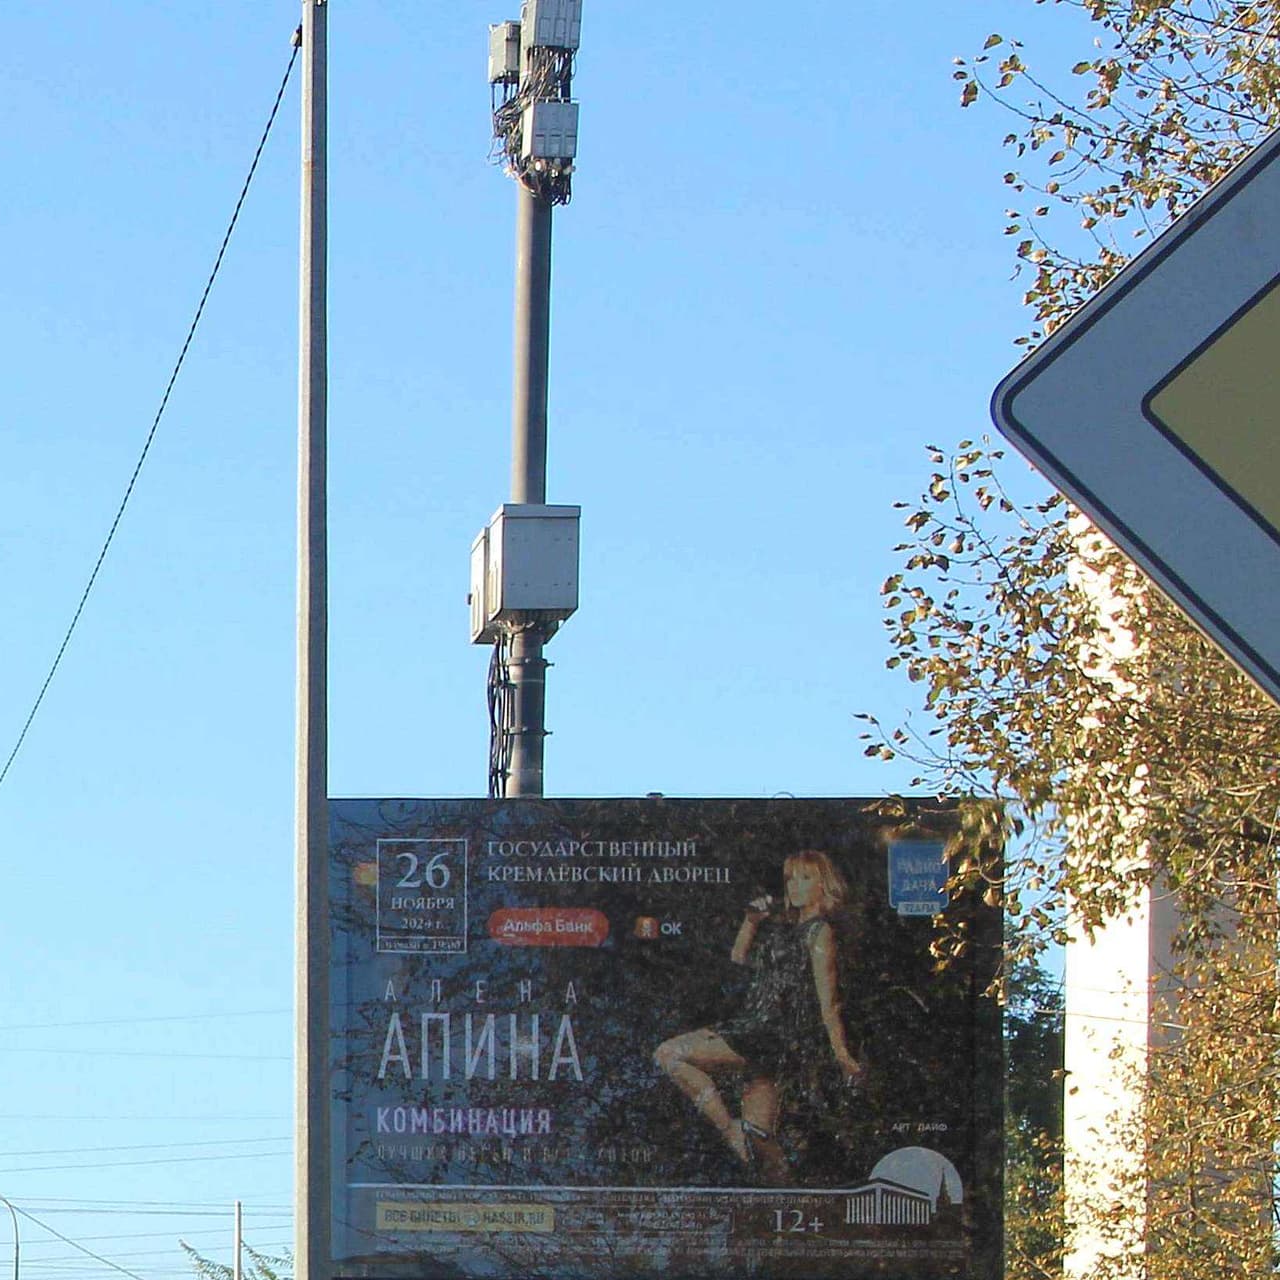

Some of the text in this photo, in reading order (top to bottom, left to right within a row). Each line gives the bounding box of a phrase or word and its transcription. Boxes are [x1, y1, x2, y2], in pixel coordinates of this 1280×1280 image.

[488, 838, 697, 857] ГОСУДАРСТВЕННЫЙ
[396, 852, 450, 888] 26
[648, 866, 730, 884] ДВОРЕЦ
[391, 897, 454, 909] НОЯБРЯ
[555, 919, 593, 933] Банк
[384, 979, 577, 1004] АЛЕНА
[377, 1013, 583, 1081] АПИНА
[376, 1106, 553, 1137] КОМБИНАЦИЯ
[772, 1209, 824, 1233] 12+
